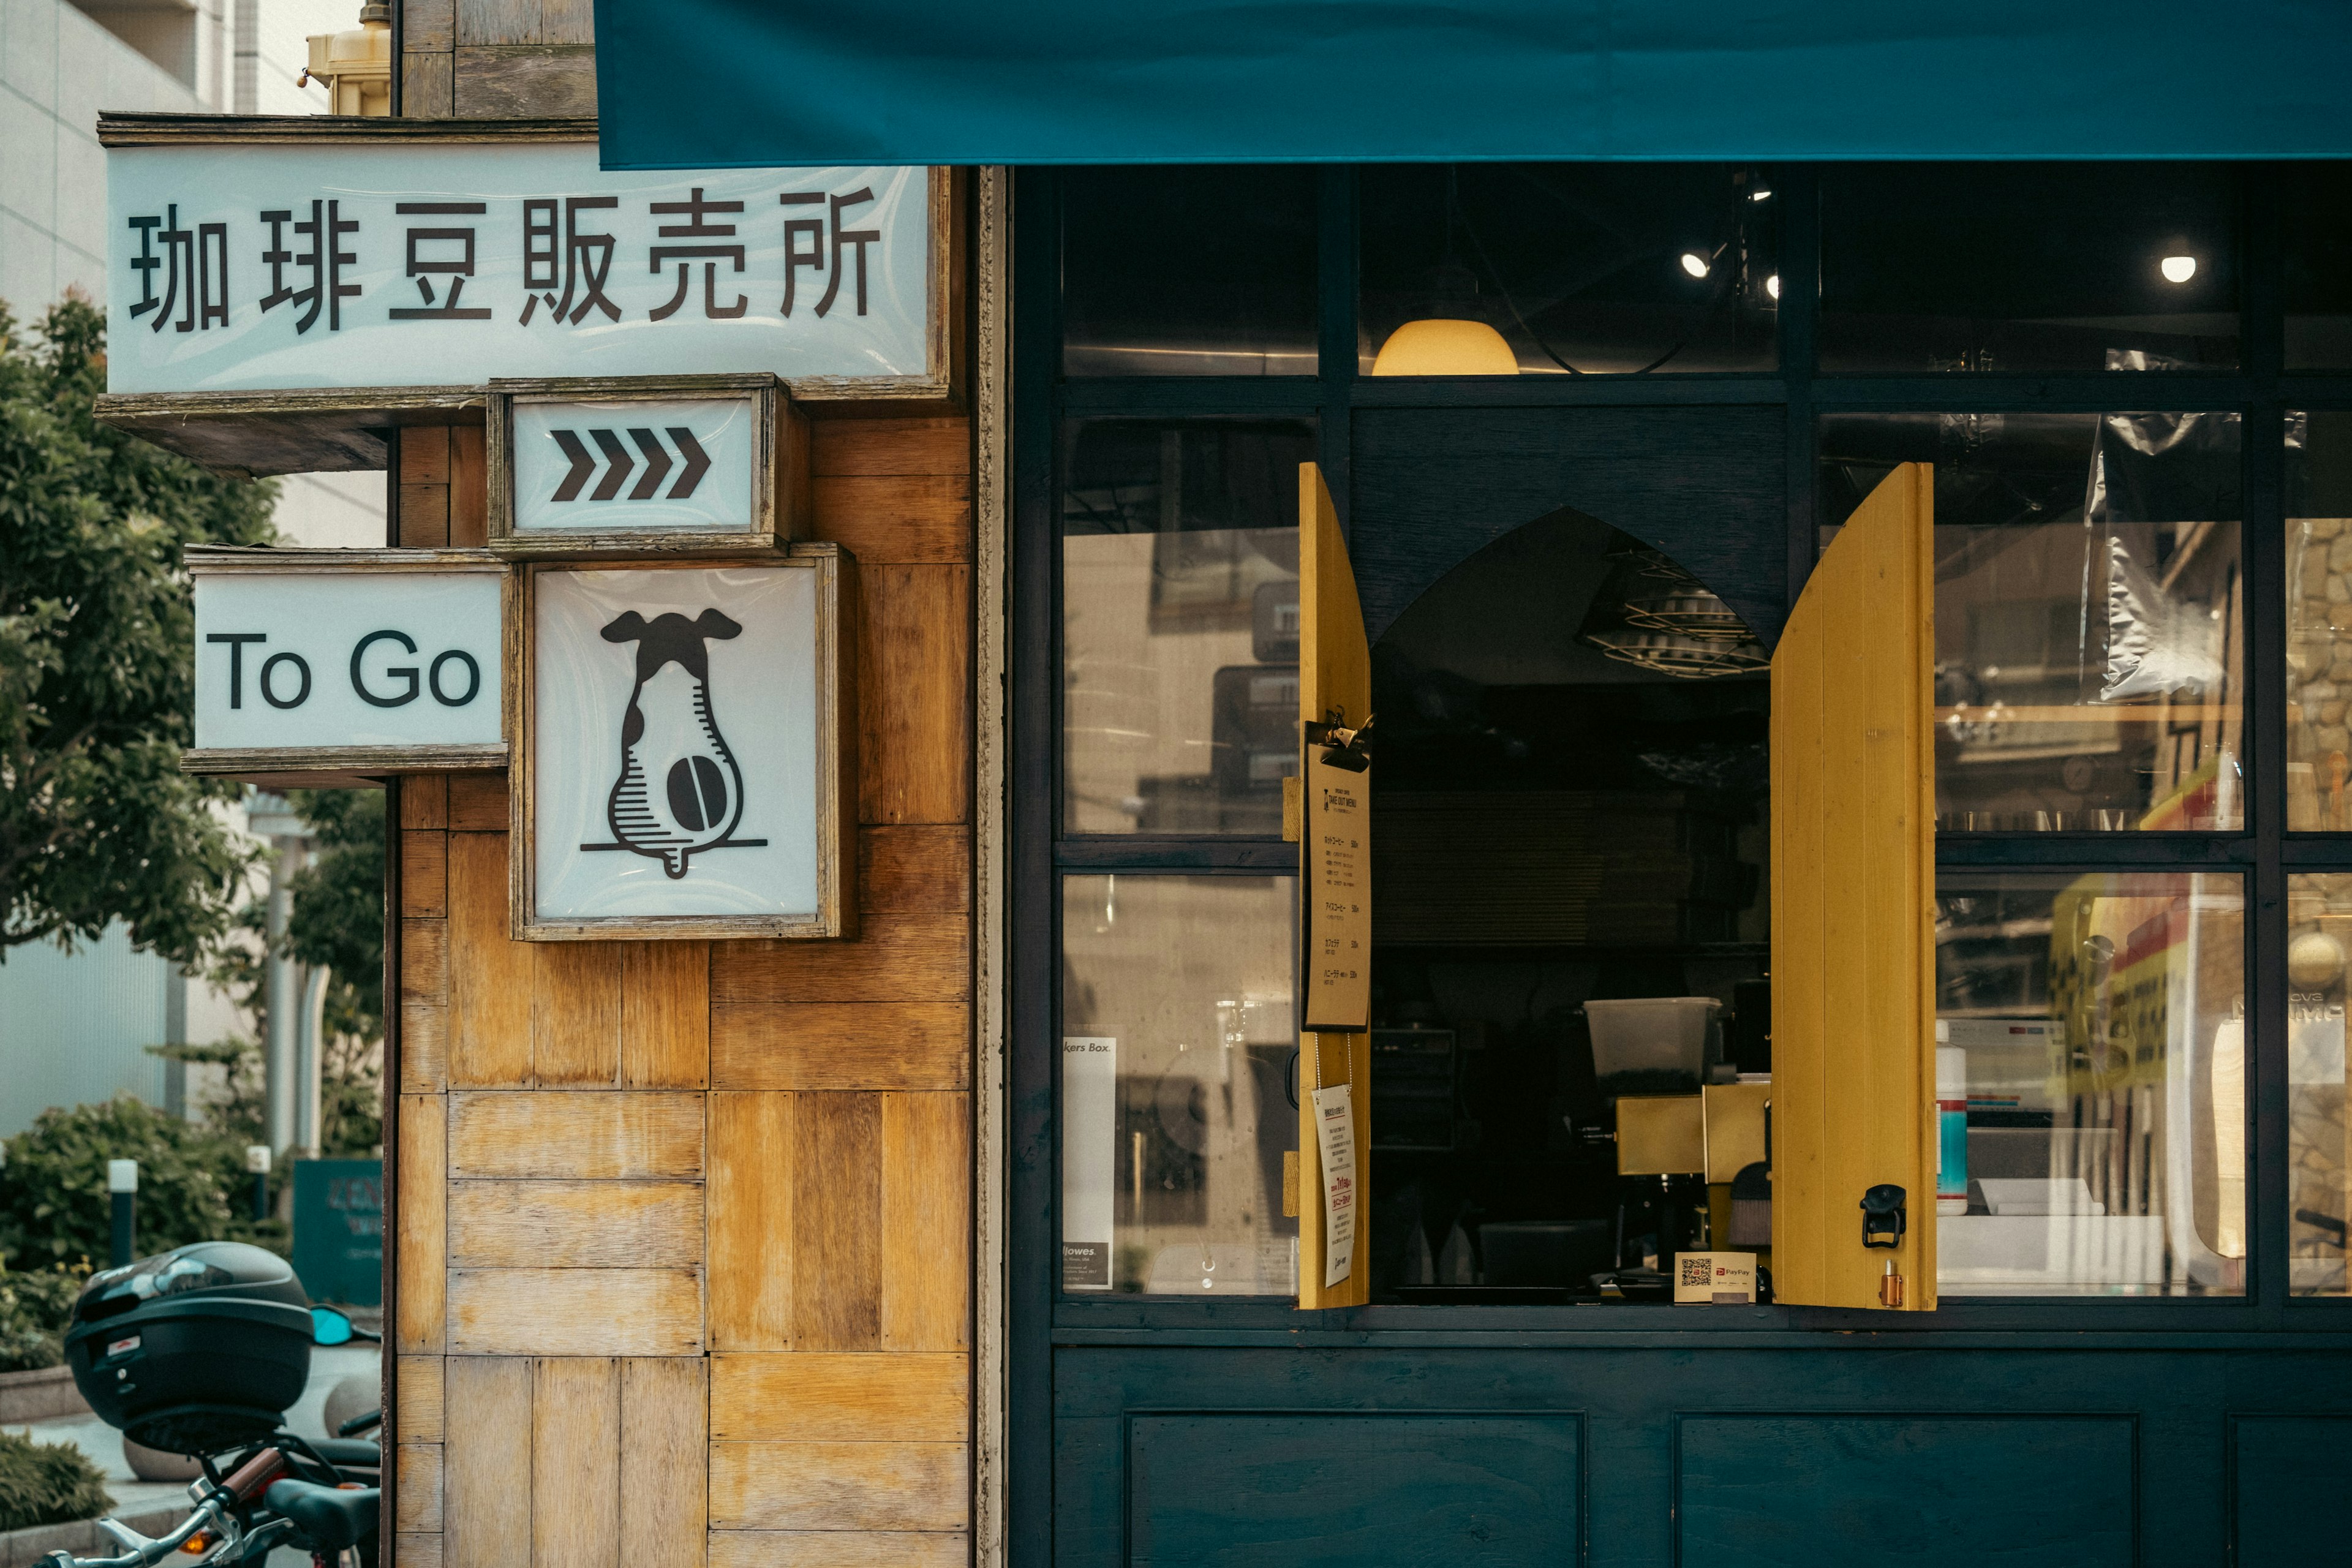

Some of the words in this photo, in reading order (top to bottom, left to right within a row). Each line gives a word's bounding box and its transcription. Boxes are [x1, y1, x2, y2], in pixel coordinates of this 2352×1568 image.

[128, 185, 880, 336] 珈琲豆販売所
[206, 631, 312, 710] To
[349, 628, 481, 709] Go
[1329, 795, 1338, 805] TAKE
[1346, 798, 1357, 808] MENU
[1325, 902, 1346, 911] アイスコーヒー
[1325, 939, 1340, 948] カフェラテ
[1324, 969, 1340, 978] ハニーラテ
